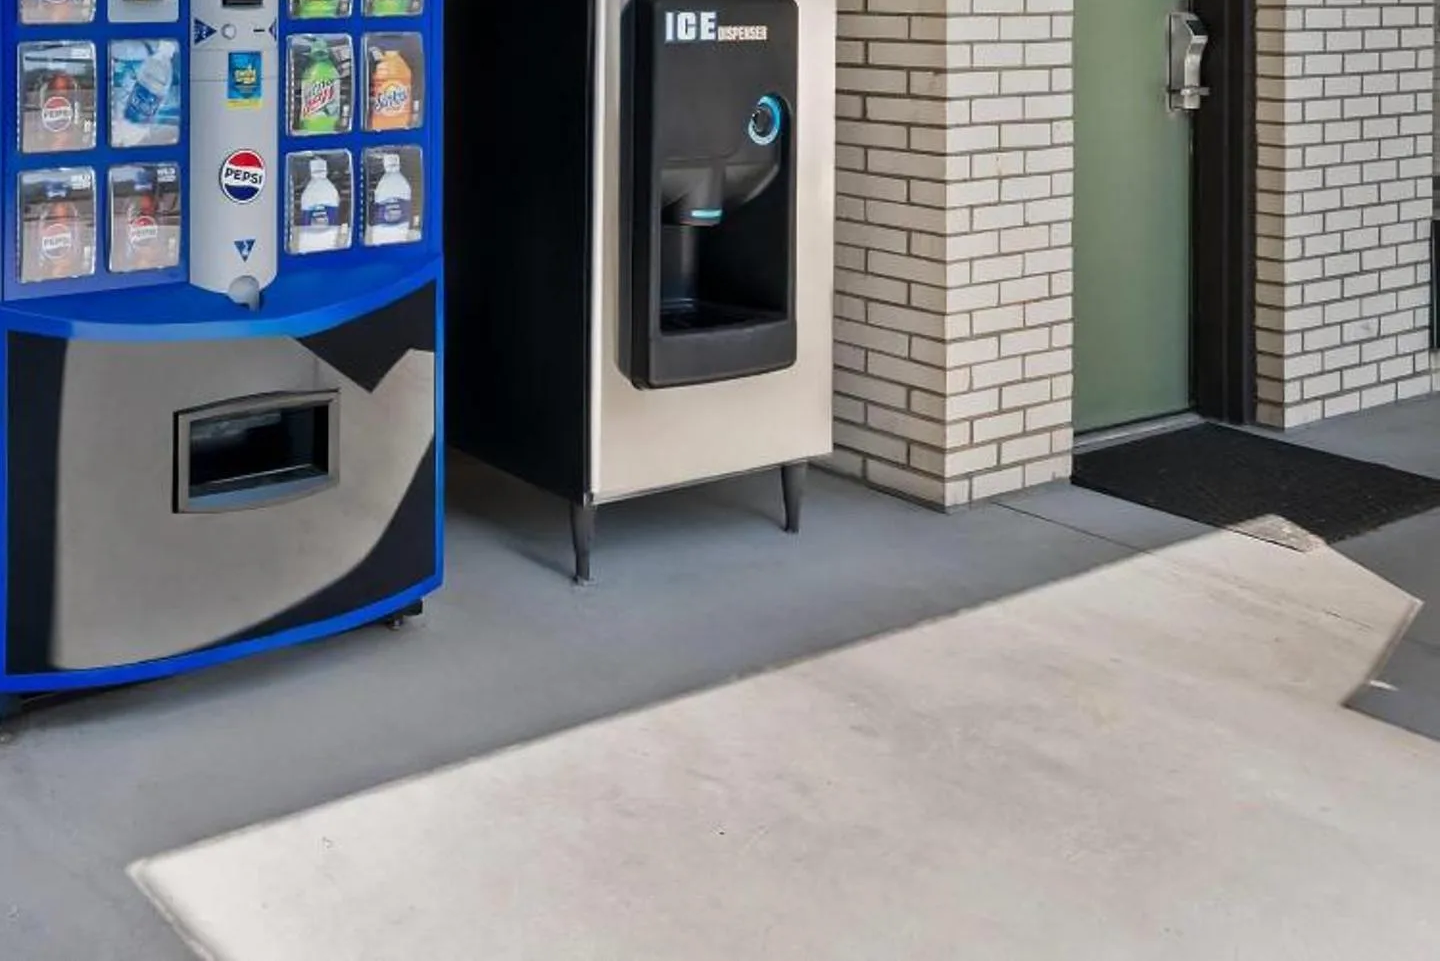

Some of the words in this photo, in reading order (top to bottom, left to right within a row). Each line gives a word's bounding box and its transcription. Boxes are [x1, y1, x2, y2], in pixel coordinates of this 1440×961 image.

[665, 11, 717, 41] ICE
[717, 25, 768, 41] DISPENSER
[224, 166, 263, 185] PEPSI
